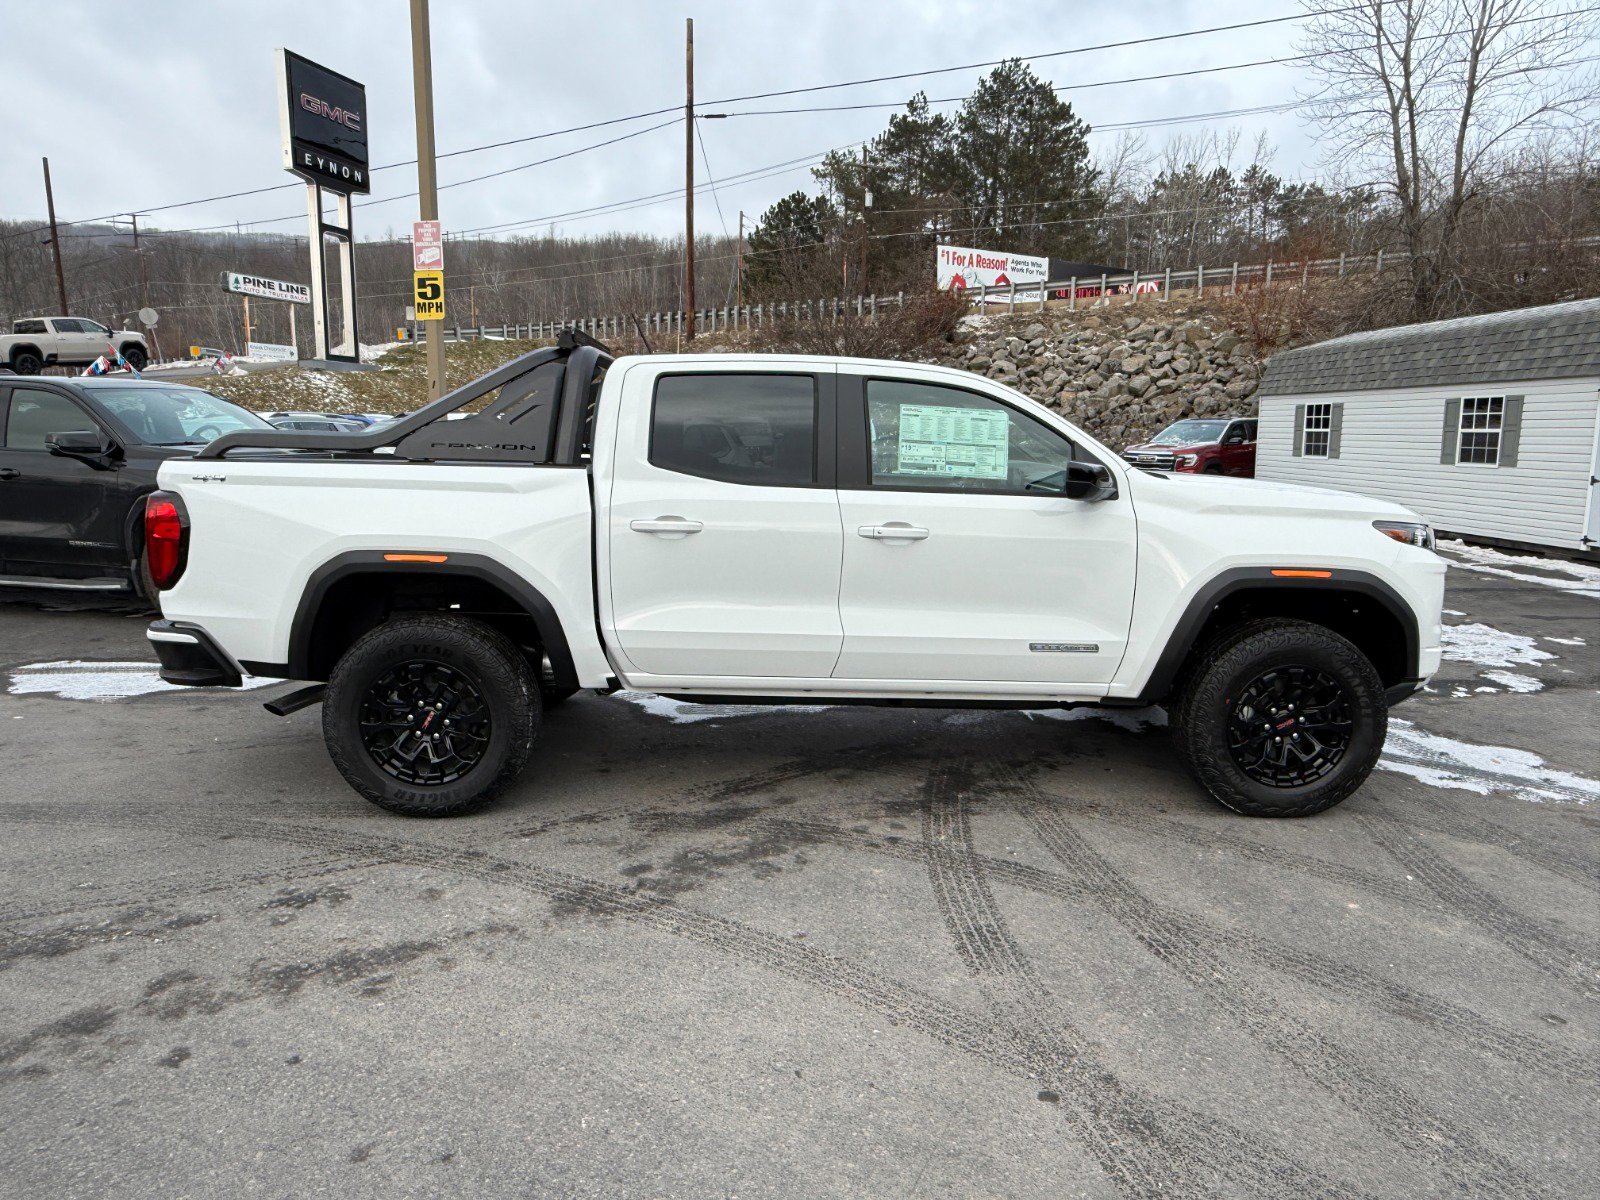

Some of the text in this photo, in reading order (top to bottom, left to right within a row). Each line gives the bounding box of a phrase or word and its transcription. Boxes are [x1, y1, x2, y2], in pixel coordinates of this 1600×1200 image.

[301, 93, 360, 131] GMC
[305, 153, 362, 183] EYNON
[941, 249, 1009, 272] #1 For A Reason!
[1011, 258, 1043, 269] Agents Who
[1010, 265, 1047, 277] Work For You!
[242, 276, 308, 296] PINE LINE
[417, 277, 441, 301] 5
[417, 302, 443, 314] MPH
[431, 442, 536, 451] CANYON
